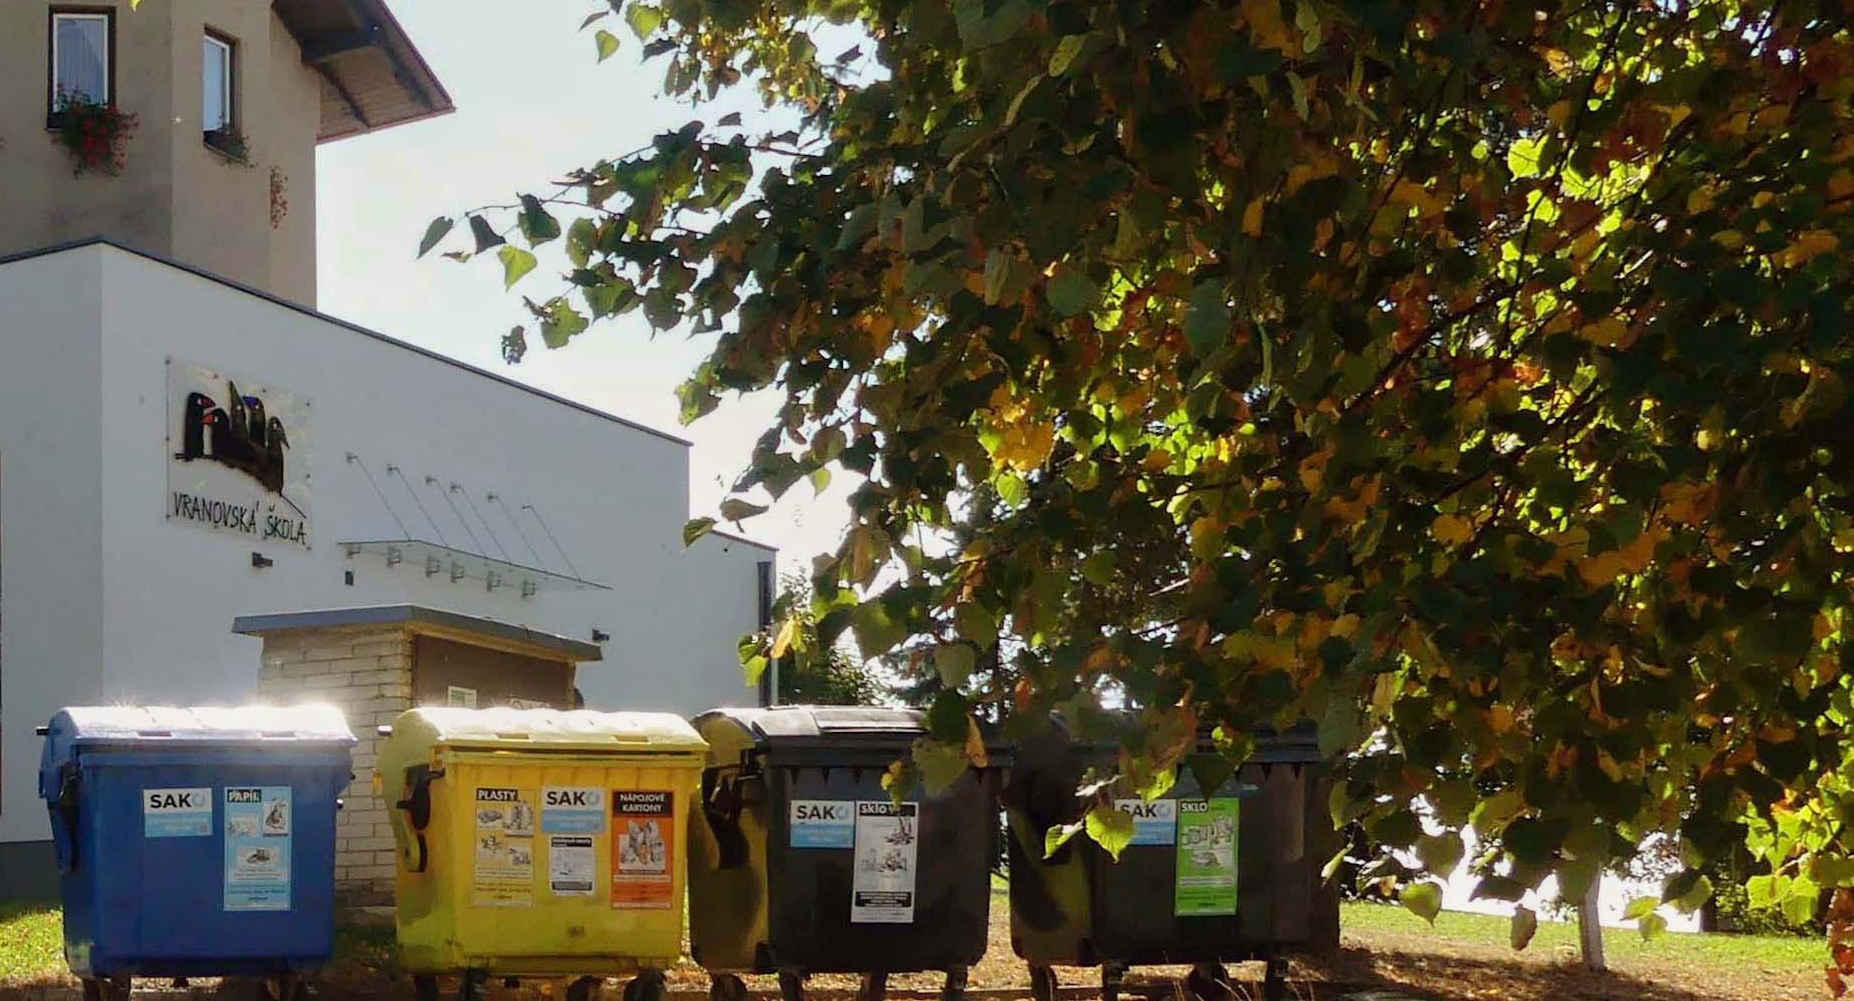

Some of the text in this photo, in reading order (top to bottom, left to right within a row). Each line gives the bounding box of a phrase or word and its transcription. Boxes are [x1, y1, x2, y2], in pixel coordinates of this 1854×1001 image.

[173, 492, 307, 545] VRANOVSKÁ ŠKOLA
[150, 793, 205, 809] SAKO
[478, 790, 517, 801] PLASTY
[622, 803, 662, 812] KARTONY
[1181, 802, 1208, 812] SKLO
